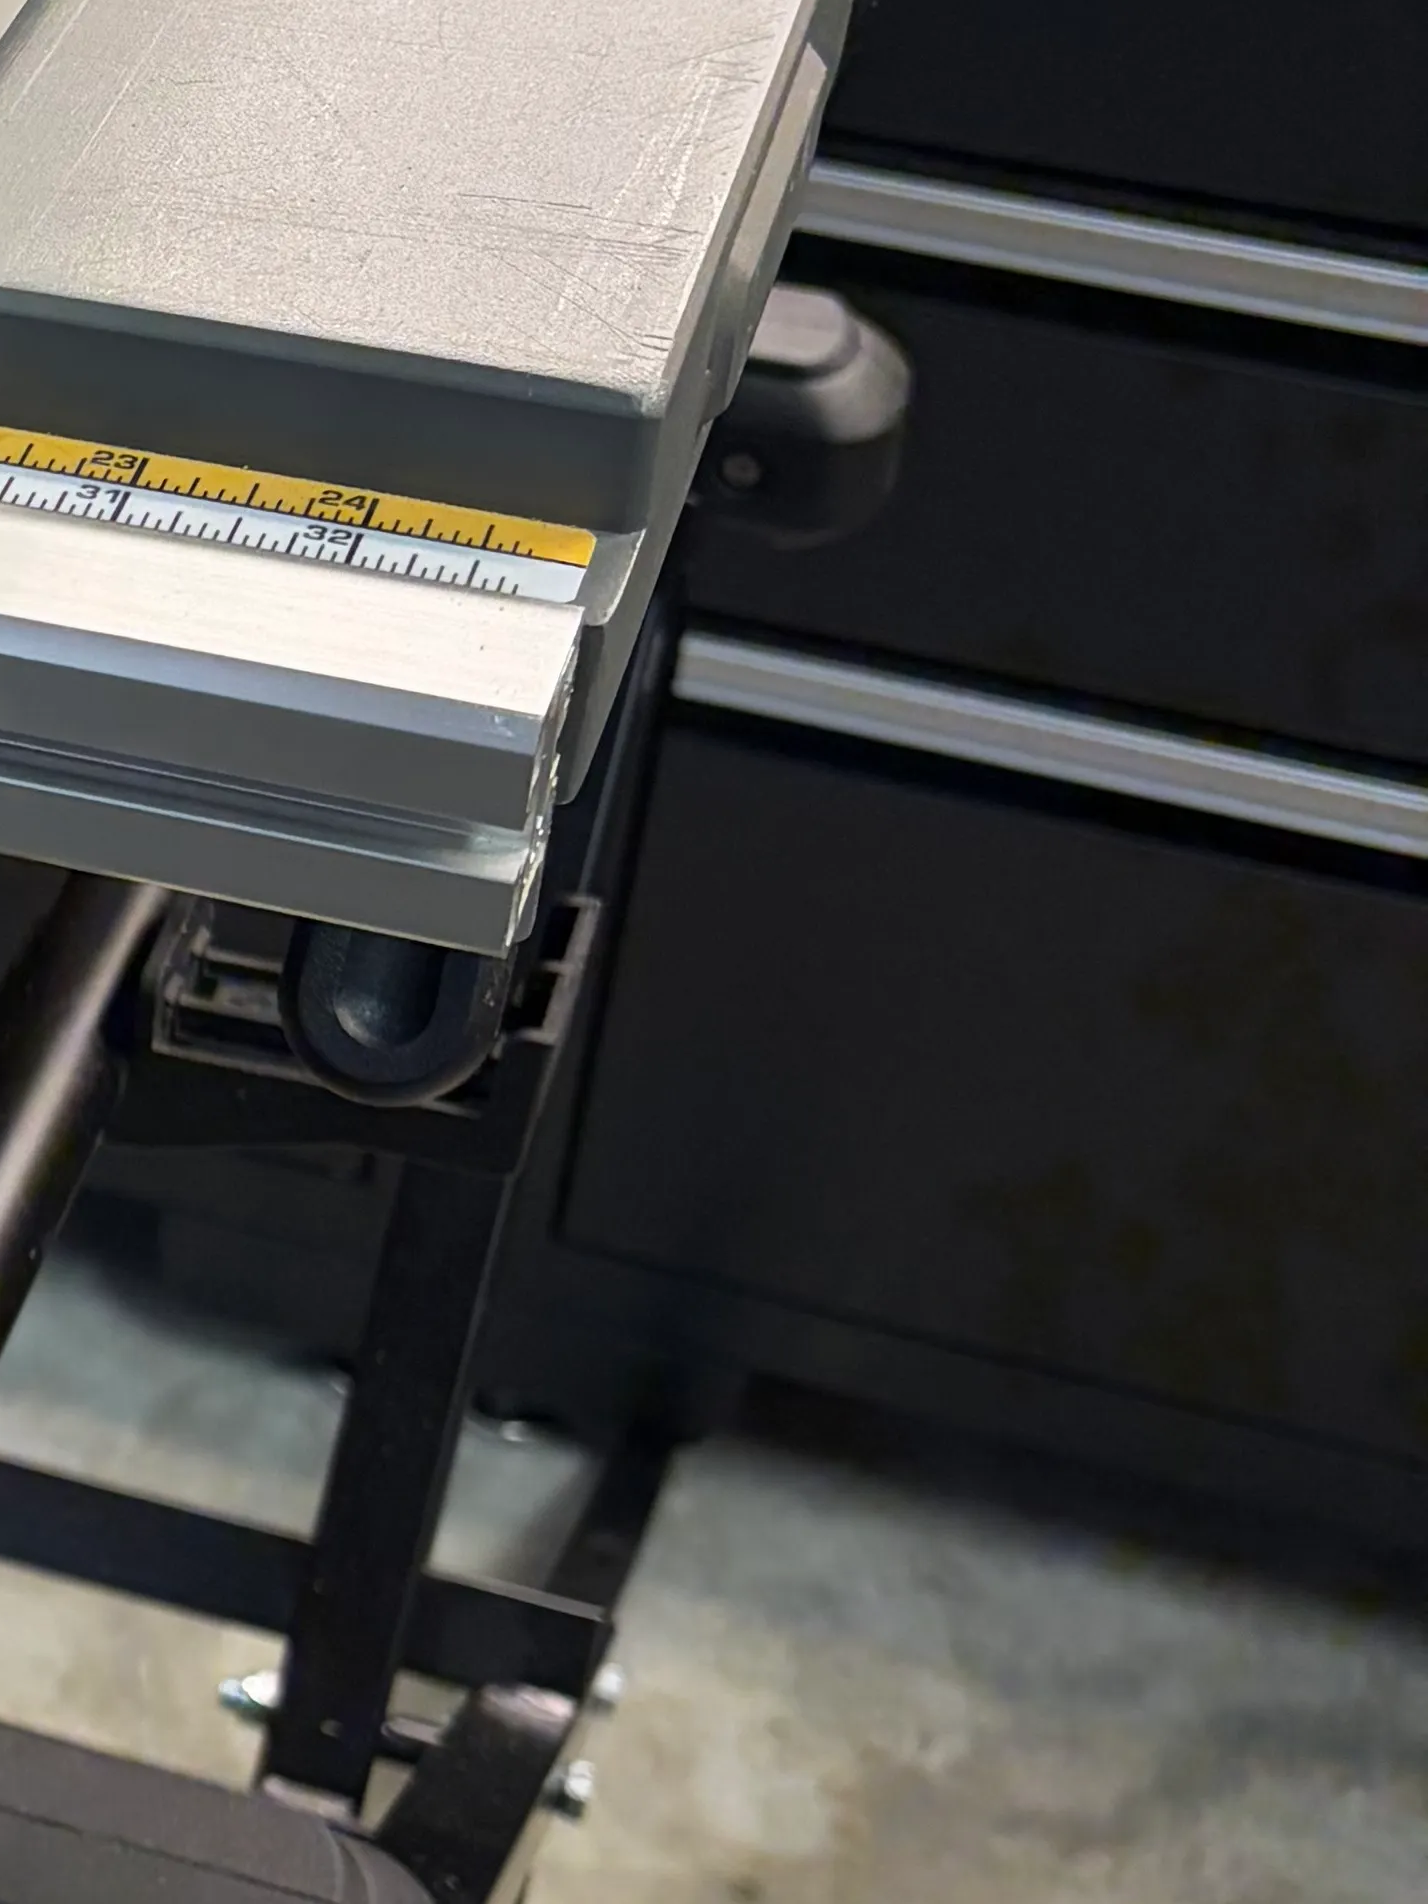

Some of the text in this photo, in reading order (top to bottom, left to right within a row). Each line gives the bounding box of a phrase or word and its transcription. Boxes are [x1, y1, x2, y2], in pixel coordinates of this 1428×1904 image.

[91, 450, 140, 471] 23
[319, 490, 368, 513] 24
[76, 484, 120, 504] 31
[304, 525, 351, 545] 32
